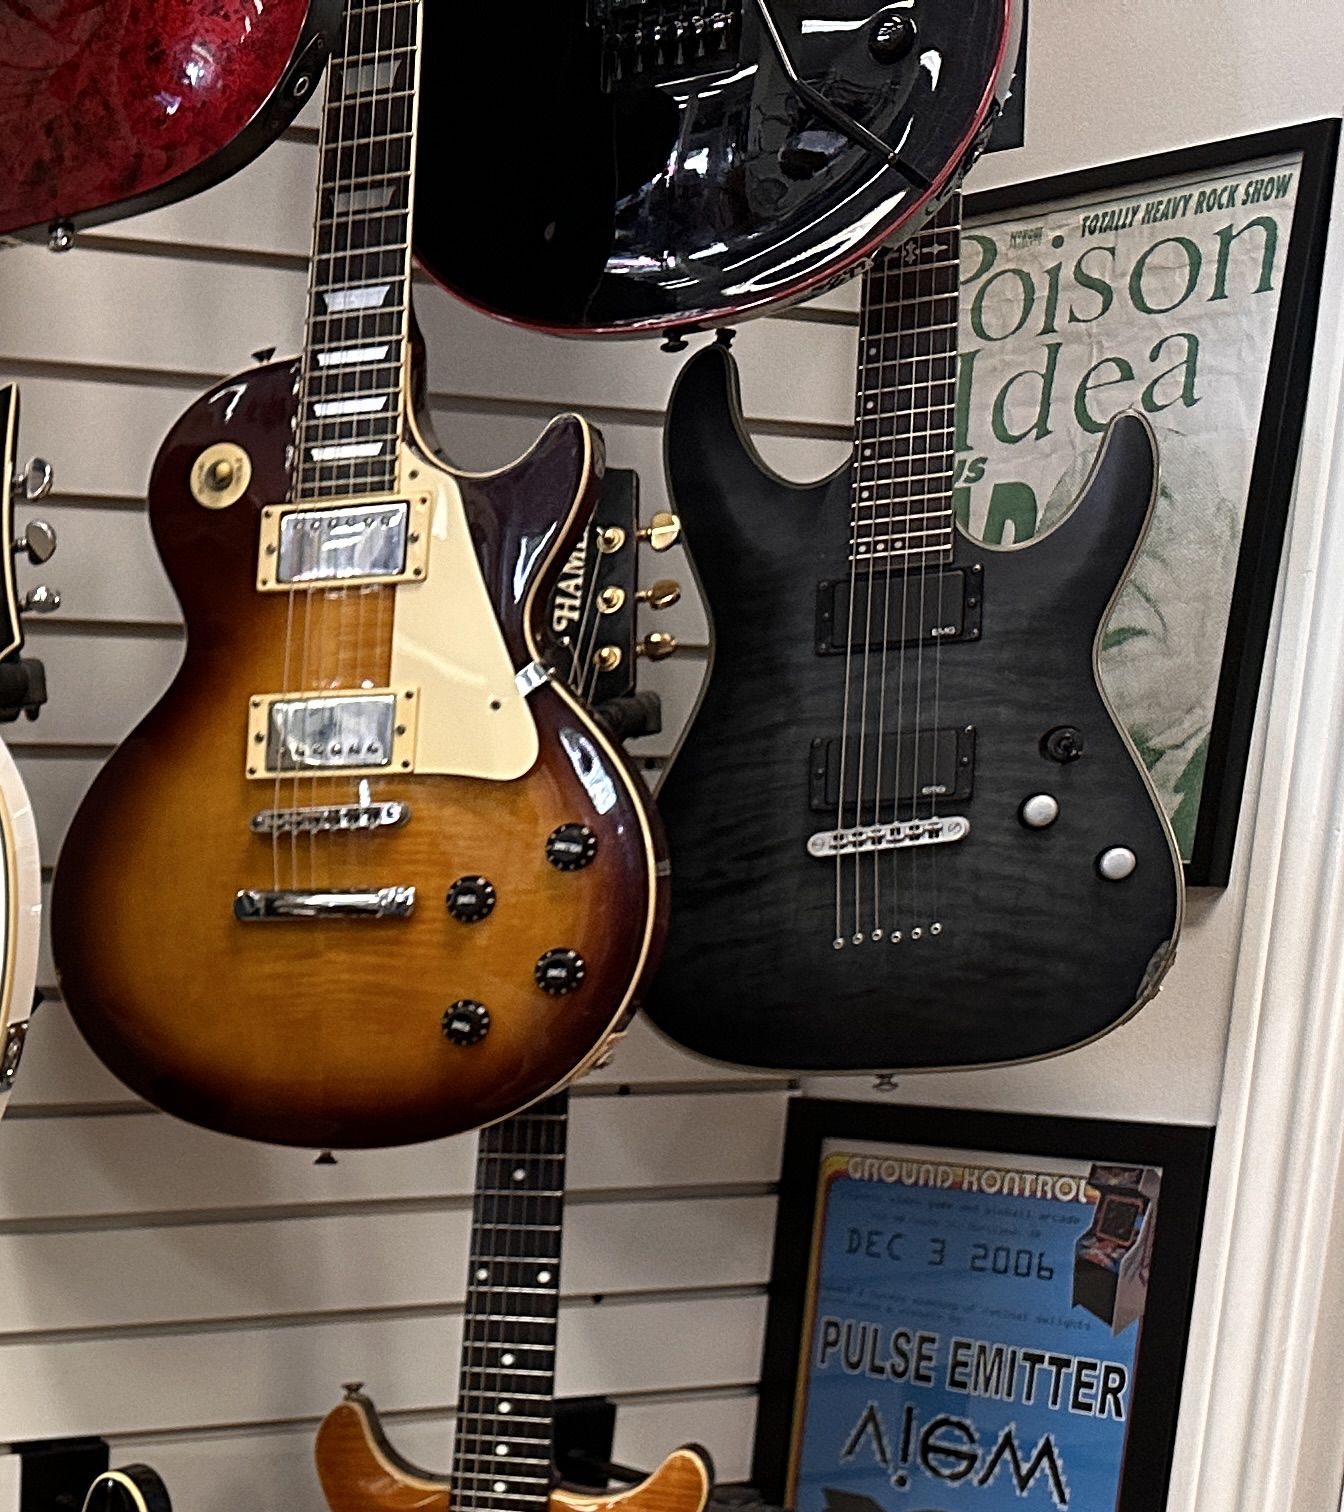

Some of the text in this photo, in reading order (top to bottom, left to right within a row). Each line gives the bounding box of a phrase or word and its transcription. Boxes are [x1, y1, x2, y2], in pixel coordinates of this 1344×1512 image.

[1080, 205, 1142, 239] TOTALLY
[1141, 193, 1194, 226] HEAVY
[1194, 183, 1240, 216] ROCK
[1241, 172, 1294, 206] SHOW
[847, 1156, 954, 1189] GROUND
[963, 1165, 1088, 1203] KONTROL
[845, 1227, 1054, 1281] DEC 3 2006
[817, 1315, 1131, 1422] PULSE EMITTER
